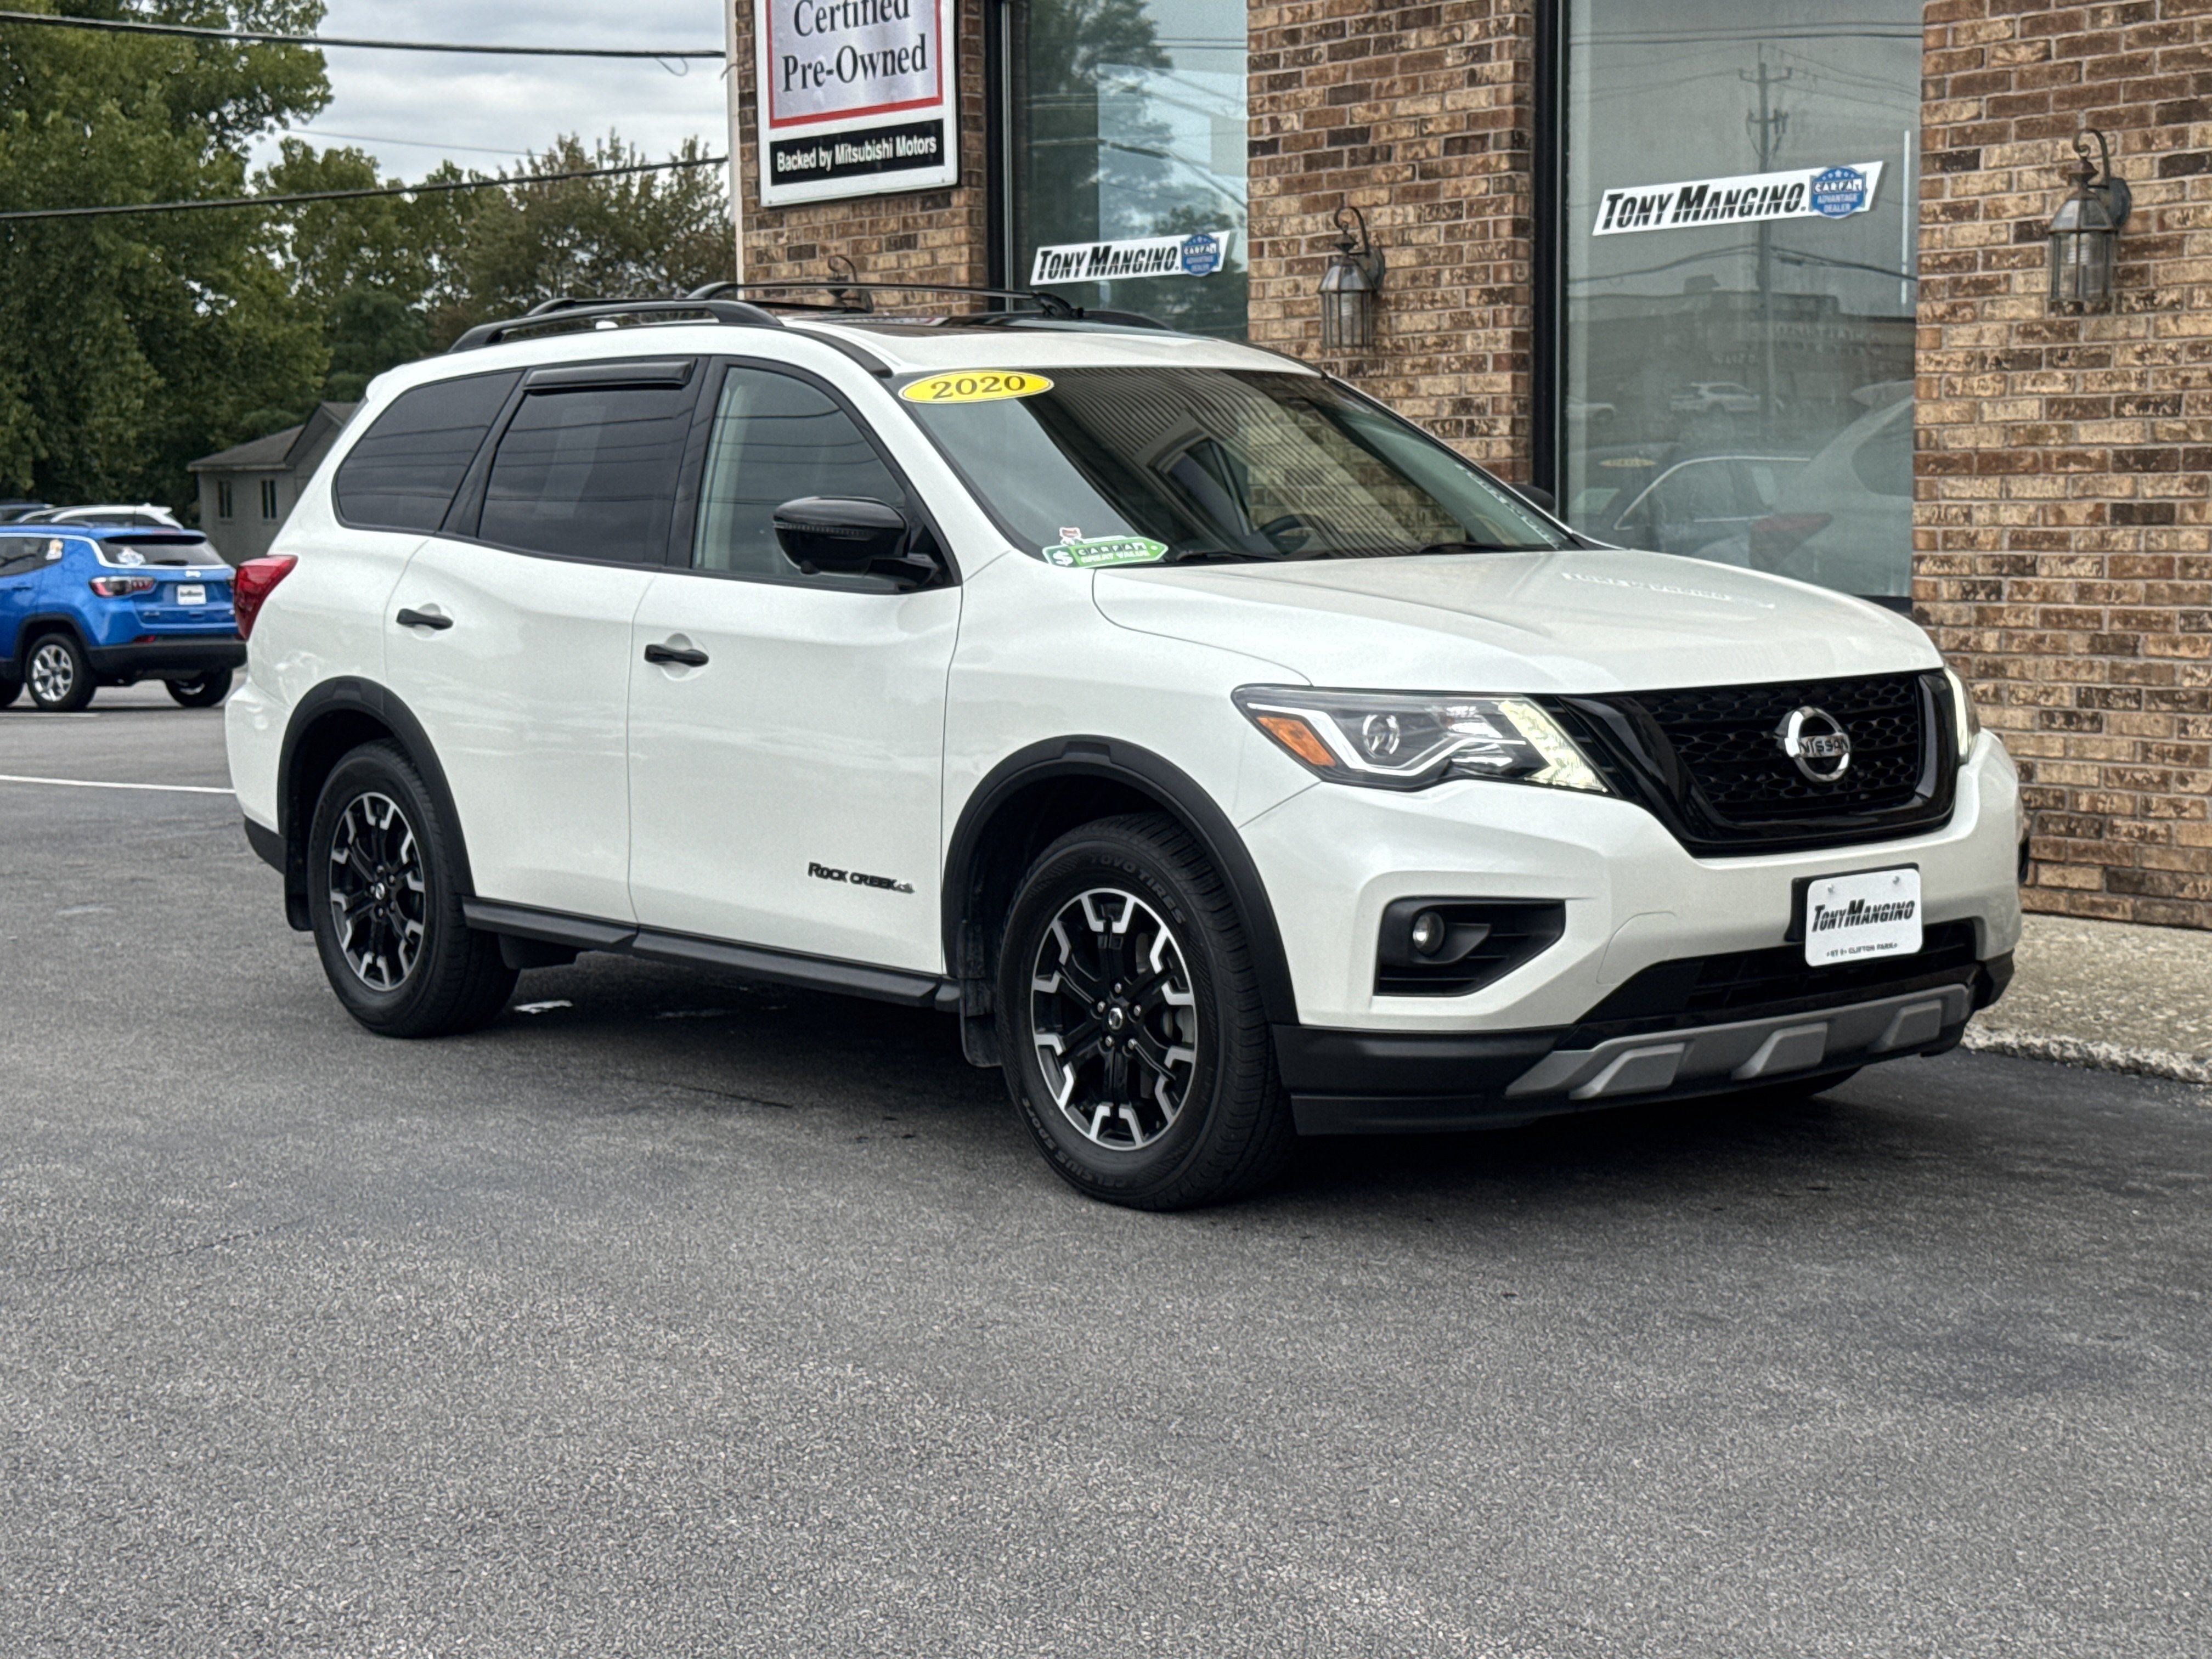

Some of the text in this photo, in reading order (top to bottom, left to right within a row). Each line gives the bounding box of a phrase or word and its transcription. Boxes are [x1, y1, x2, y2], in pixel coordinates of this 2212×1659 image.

[782, 33, 927, 92] Pre-Owned
[776, 135, 936, 172] Backed by Mitsubishi Motors
[1602, 193, 1674, 230] TONY
[1037, 250, 1087, 281] TONY
[930, 375, 1025, 399] 2020
[1799, 737, 1849, 755] NISSAN
[808, 861, 897, 891] ROCK CREEK
